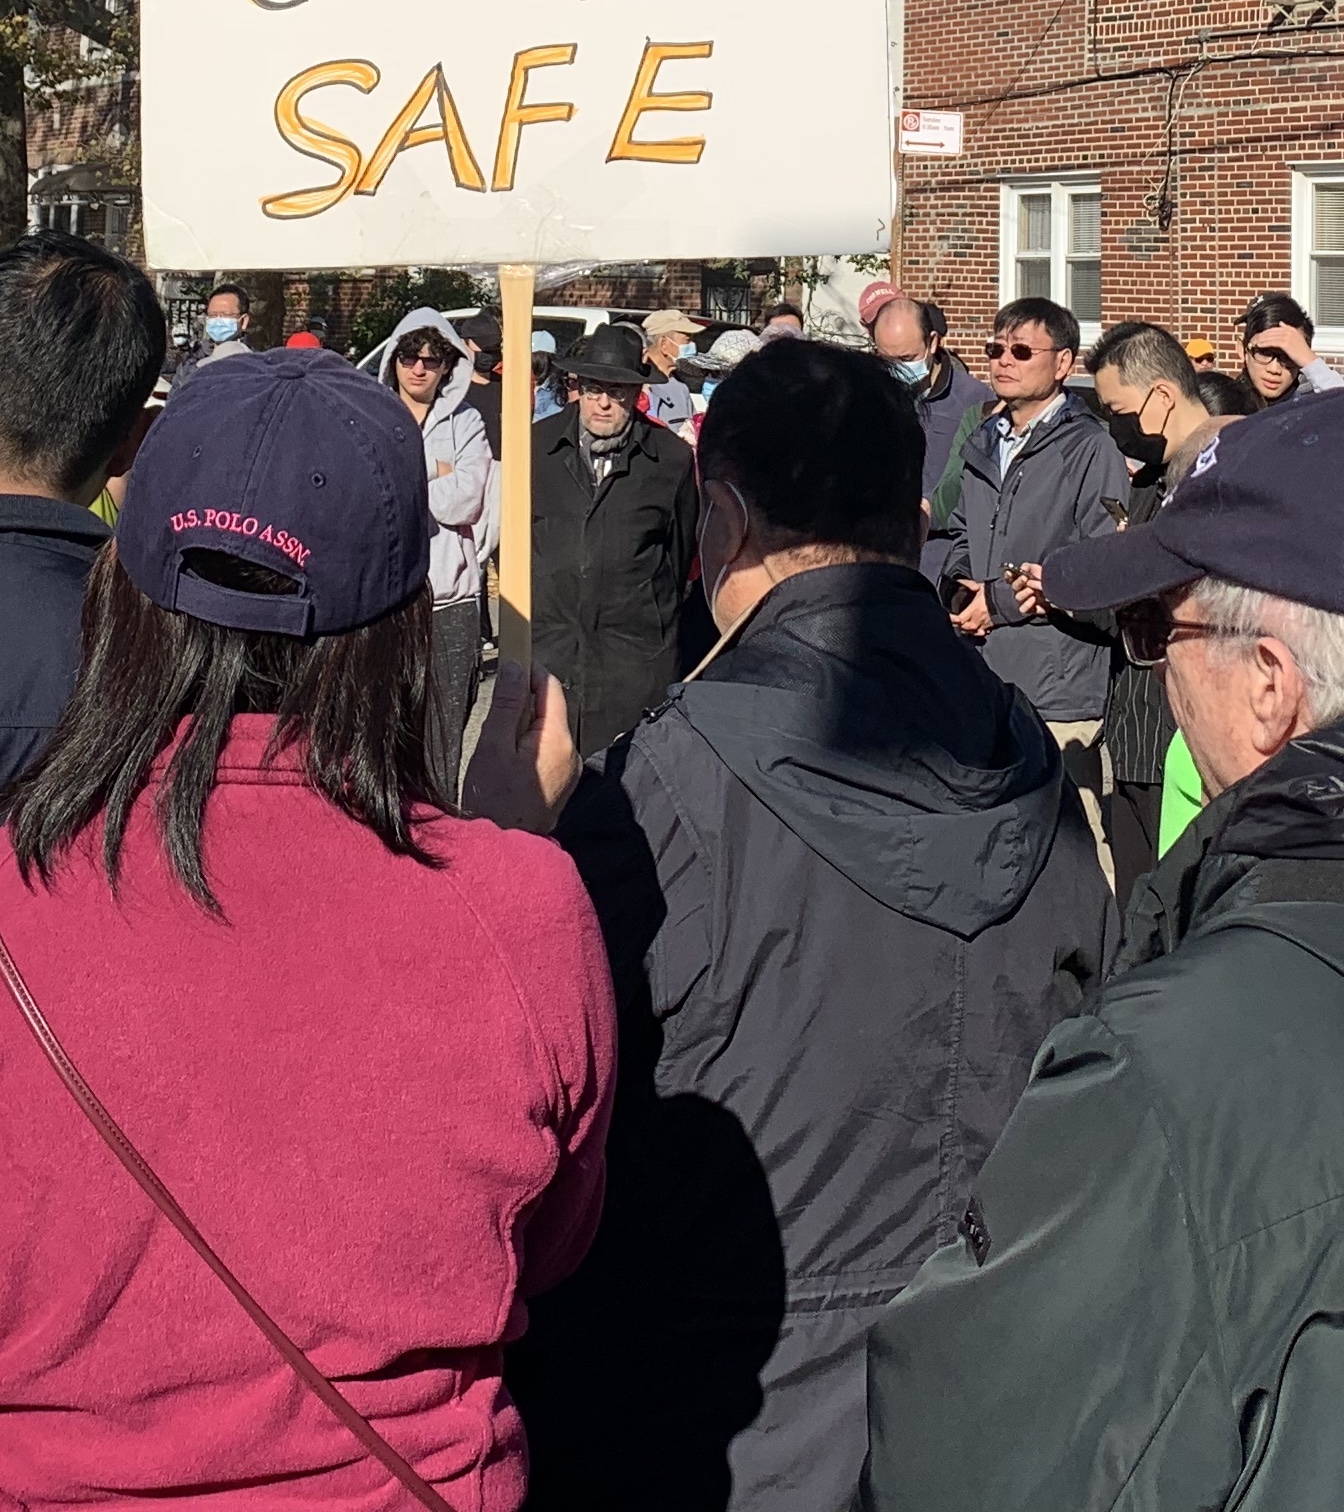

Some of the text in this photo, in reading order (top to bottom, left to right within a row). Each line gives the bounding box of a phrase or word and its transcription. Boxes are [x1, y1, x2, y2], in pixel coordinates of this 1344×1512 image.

[259, 35, 715, 221] SAFE
[170, 509, 201, 532] U.S.
[203, 508, 259, 536] POLO
